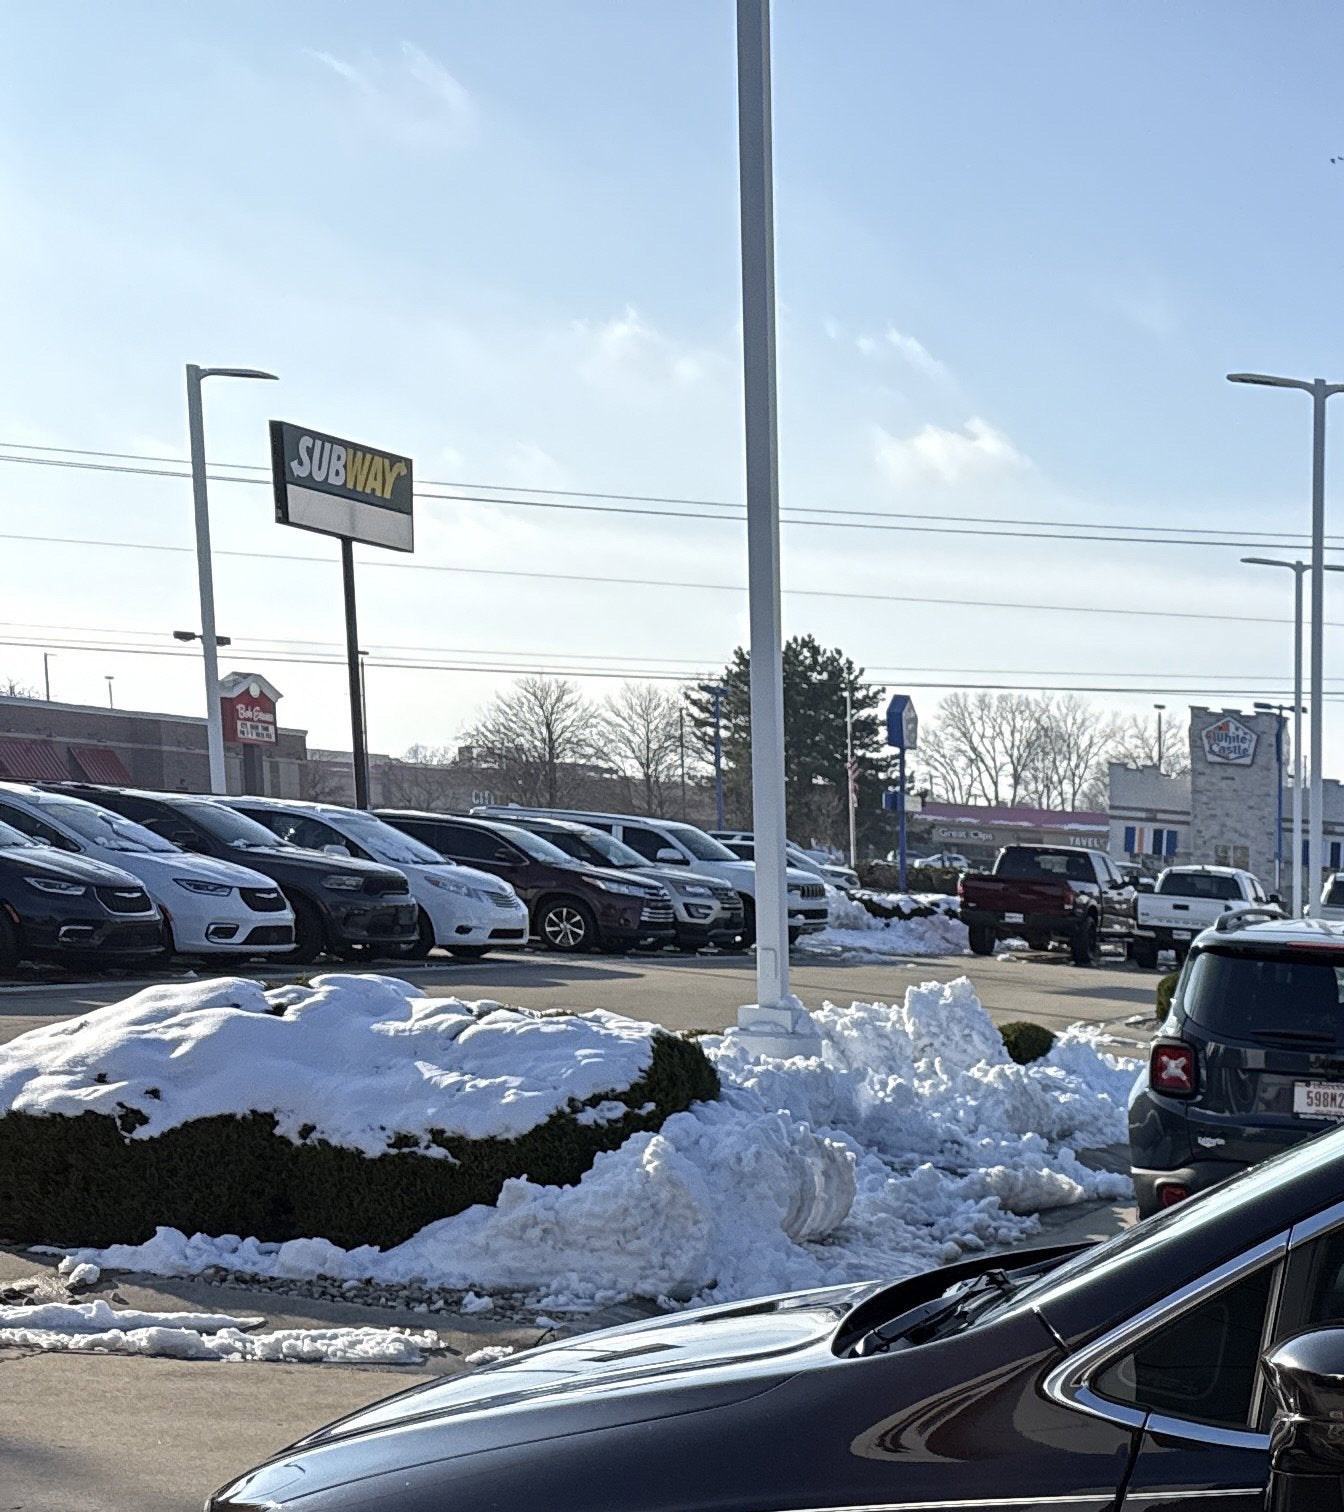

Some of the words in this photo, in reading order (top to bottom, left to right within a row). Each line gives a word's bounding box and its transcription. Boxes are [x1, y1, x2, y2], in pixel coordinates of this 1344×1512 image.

[290, 436, 407, 499] SUBWAY
[1214, 732, 1248, 744] White
[1210, 743, 1249, 756] Castle
